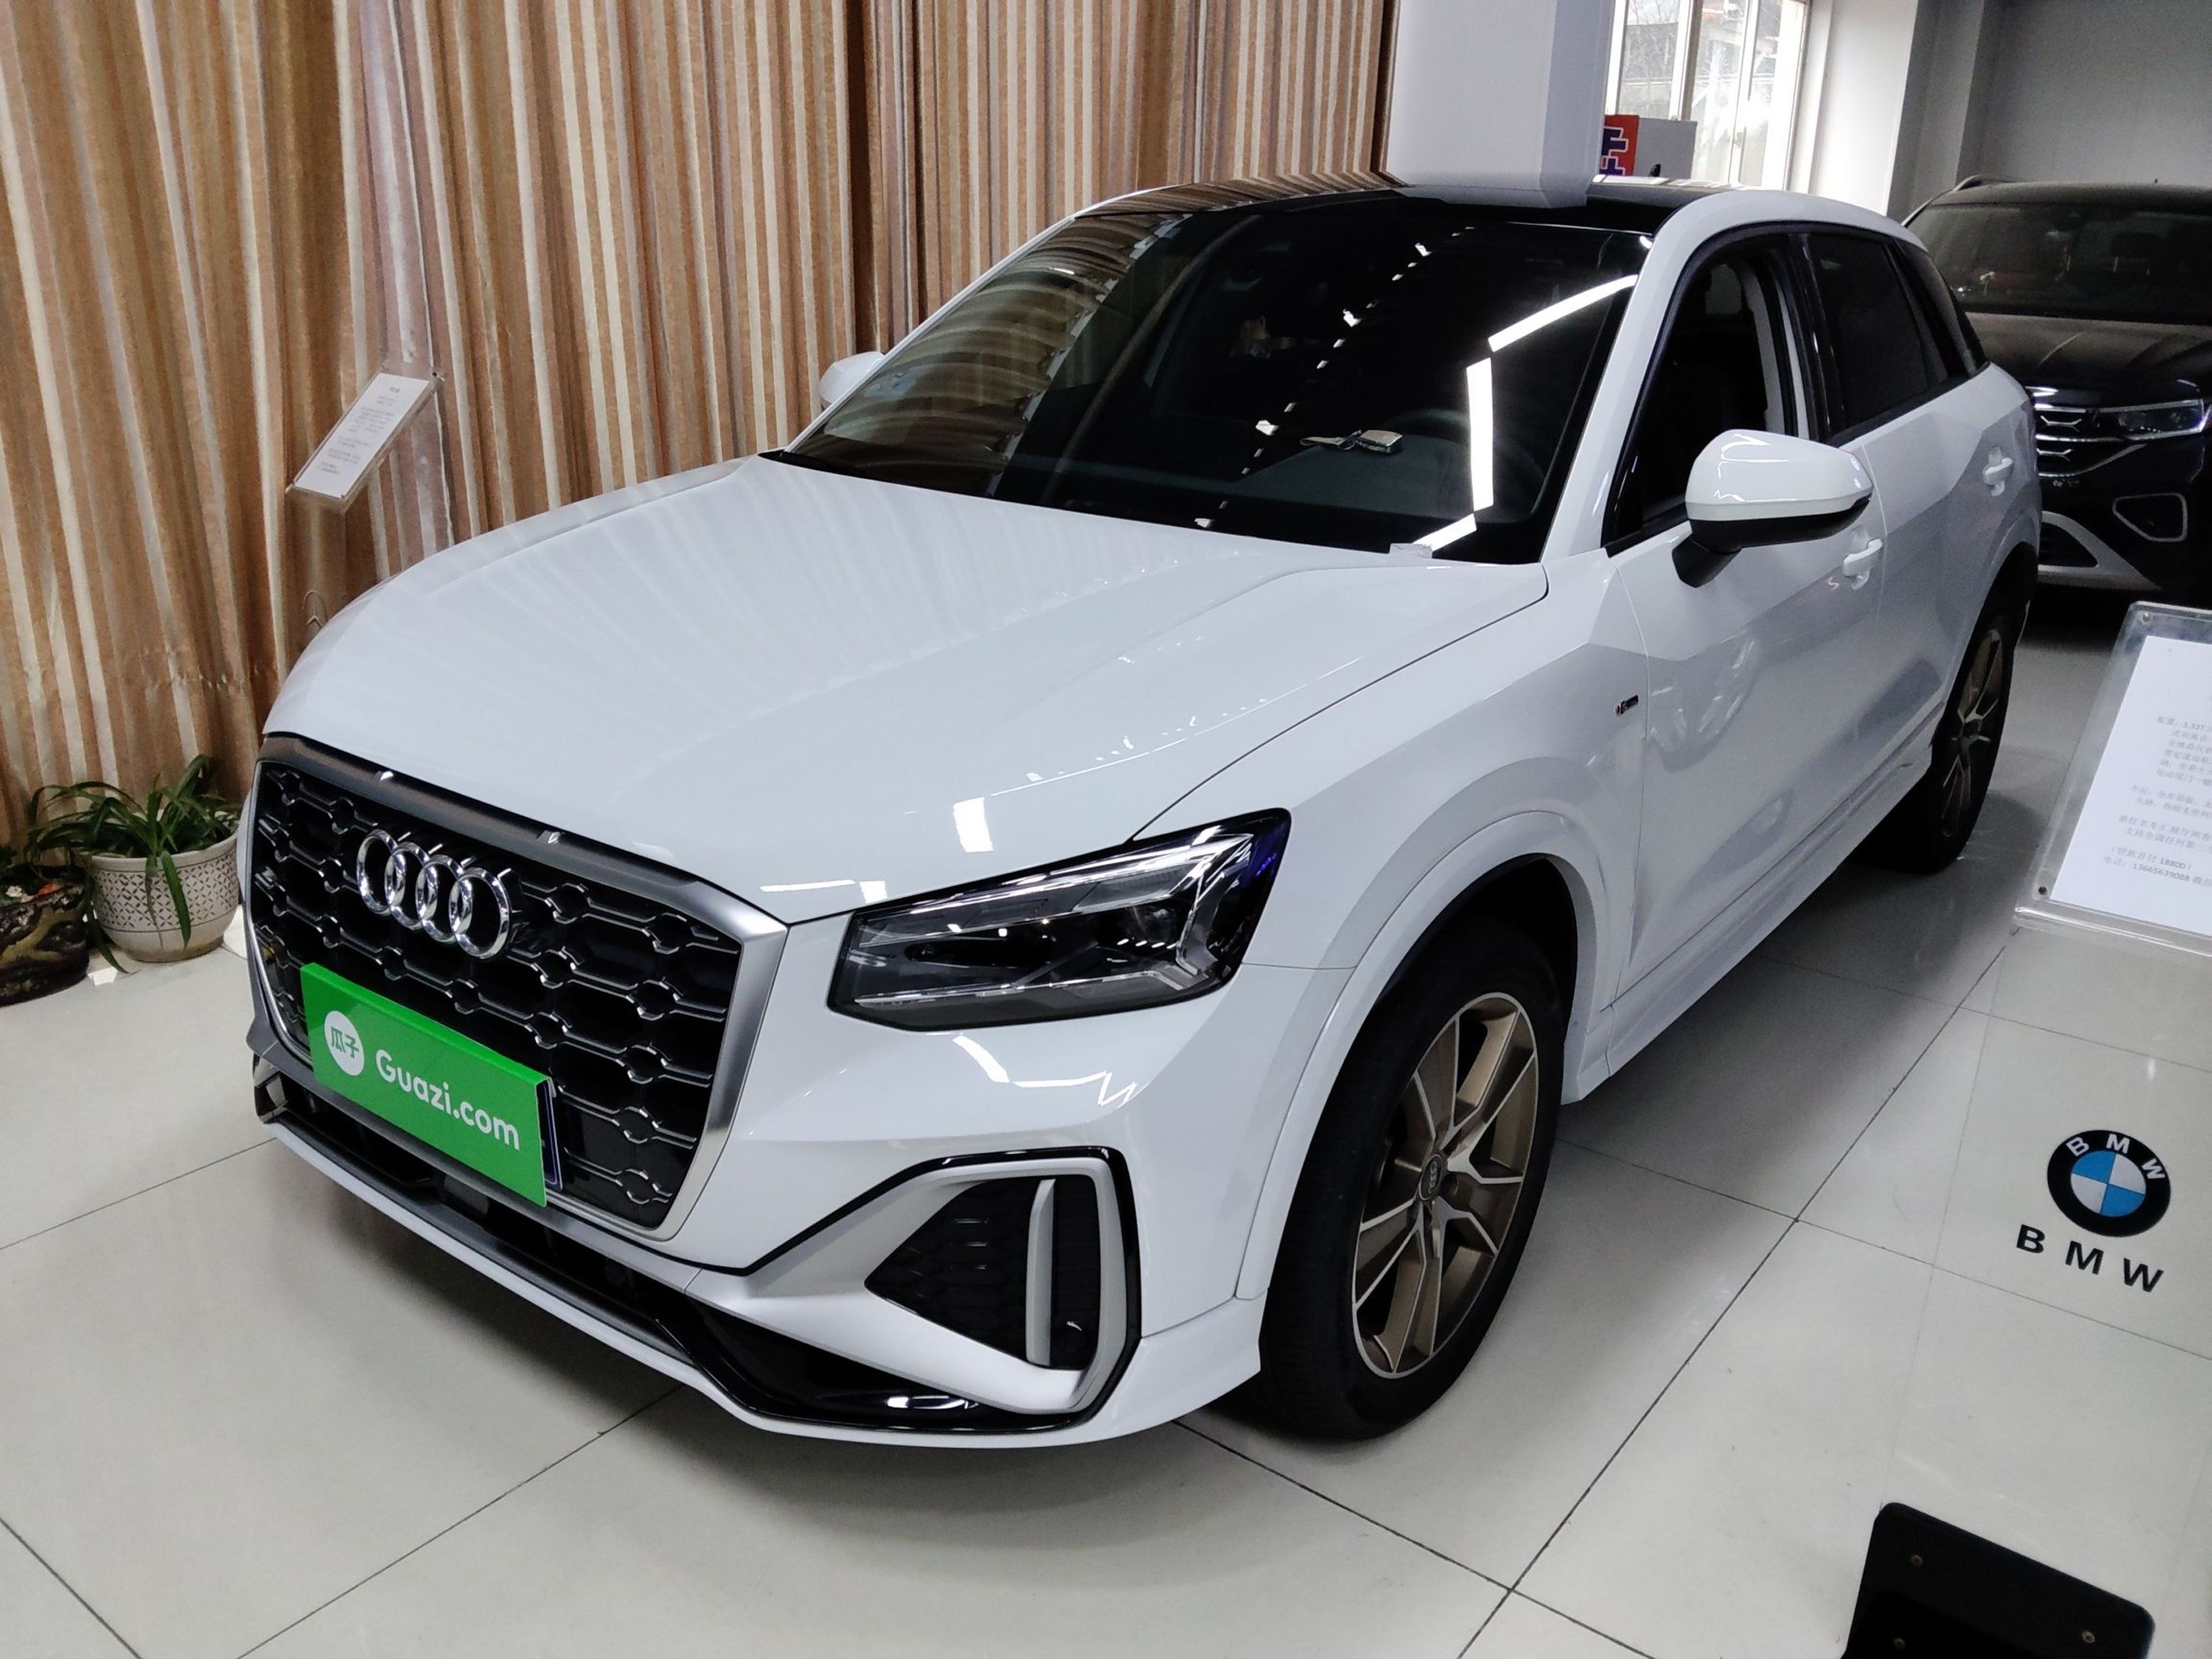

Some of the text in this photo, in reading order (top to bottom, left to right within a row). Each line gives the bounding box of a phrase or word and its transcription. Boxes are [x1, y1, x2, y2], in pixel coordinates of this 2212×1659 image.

[330, 1025, 359, 1059] 瓜子
[376, 1048, 520, 1151] Guazi.com
[2066, 1133, 2165, 1180] BMW
[2016, 1224, 2164, 1293] BMW
